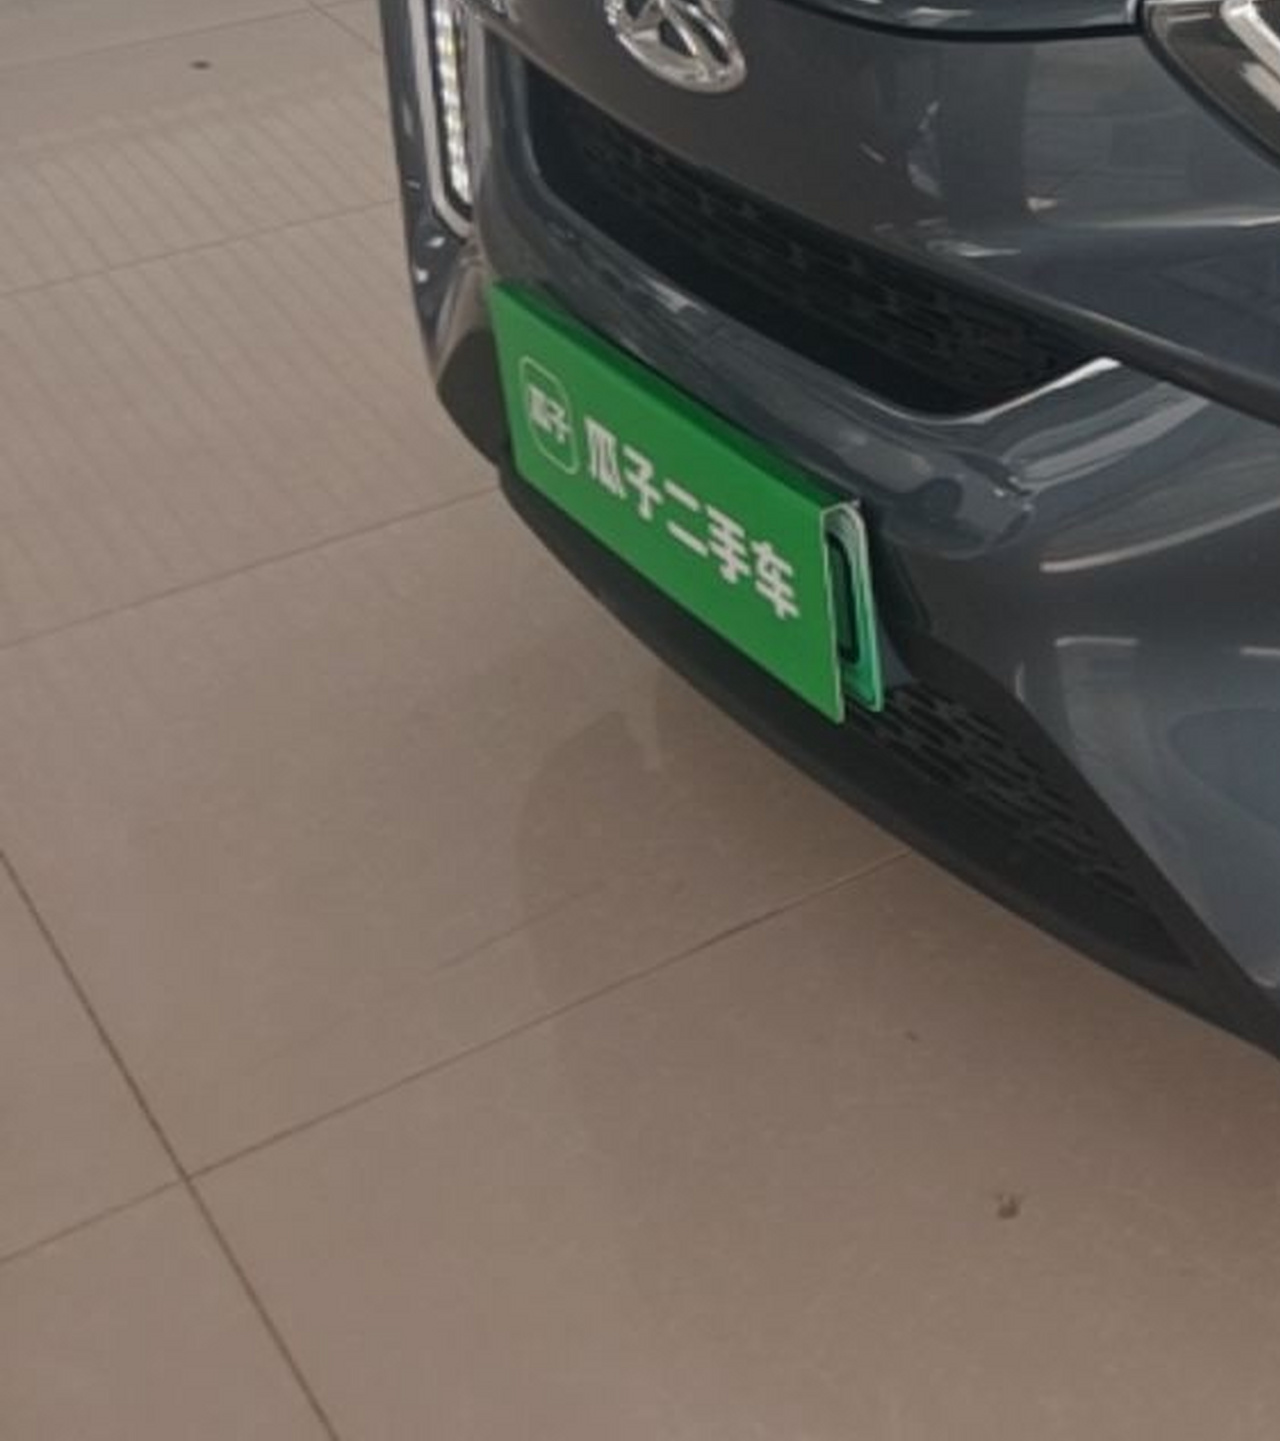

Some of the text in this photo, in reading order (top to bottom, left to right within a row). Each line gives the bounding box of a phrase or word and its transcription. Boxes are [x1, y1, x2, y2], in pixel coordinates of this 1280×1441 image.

[584, 417, 798, 619] 瓜子二手车
